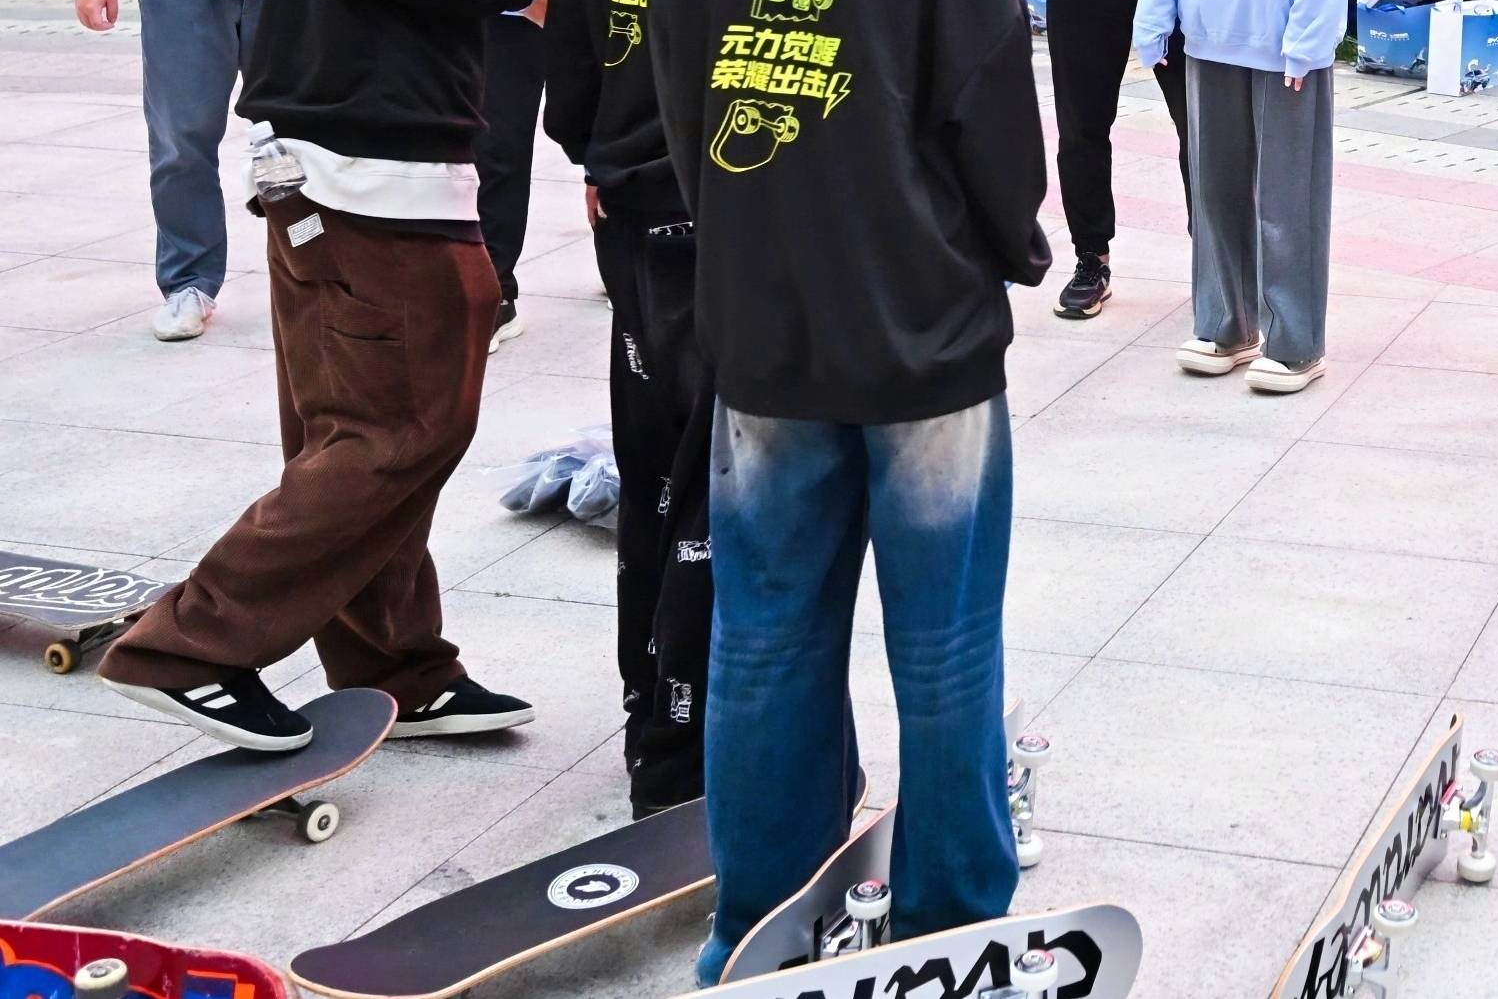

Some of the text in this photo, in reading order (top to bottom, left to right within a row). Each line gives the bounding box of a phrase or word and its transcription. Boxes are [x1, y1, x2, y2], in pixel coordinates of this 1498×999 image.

[719, 24, 842, 67] 元力觉醒
[710, 58, 829, 99] 荣耀出击
